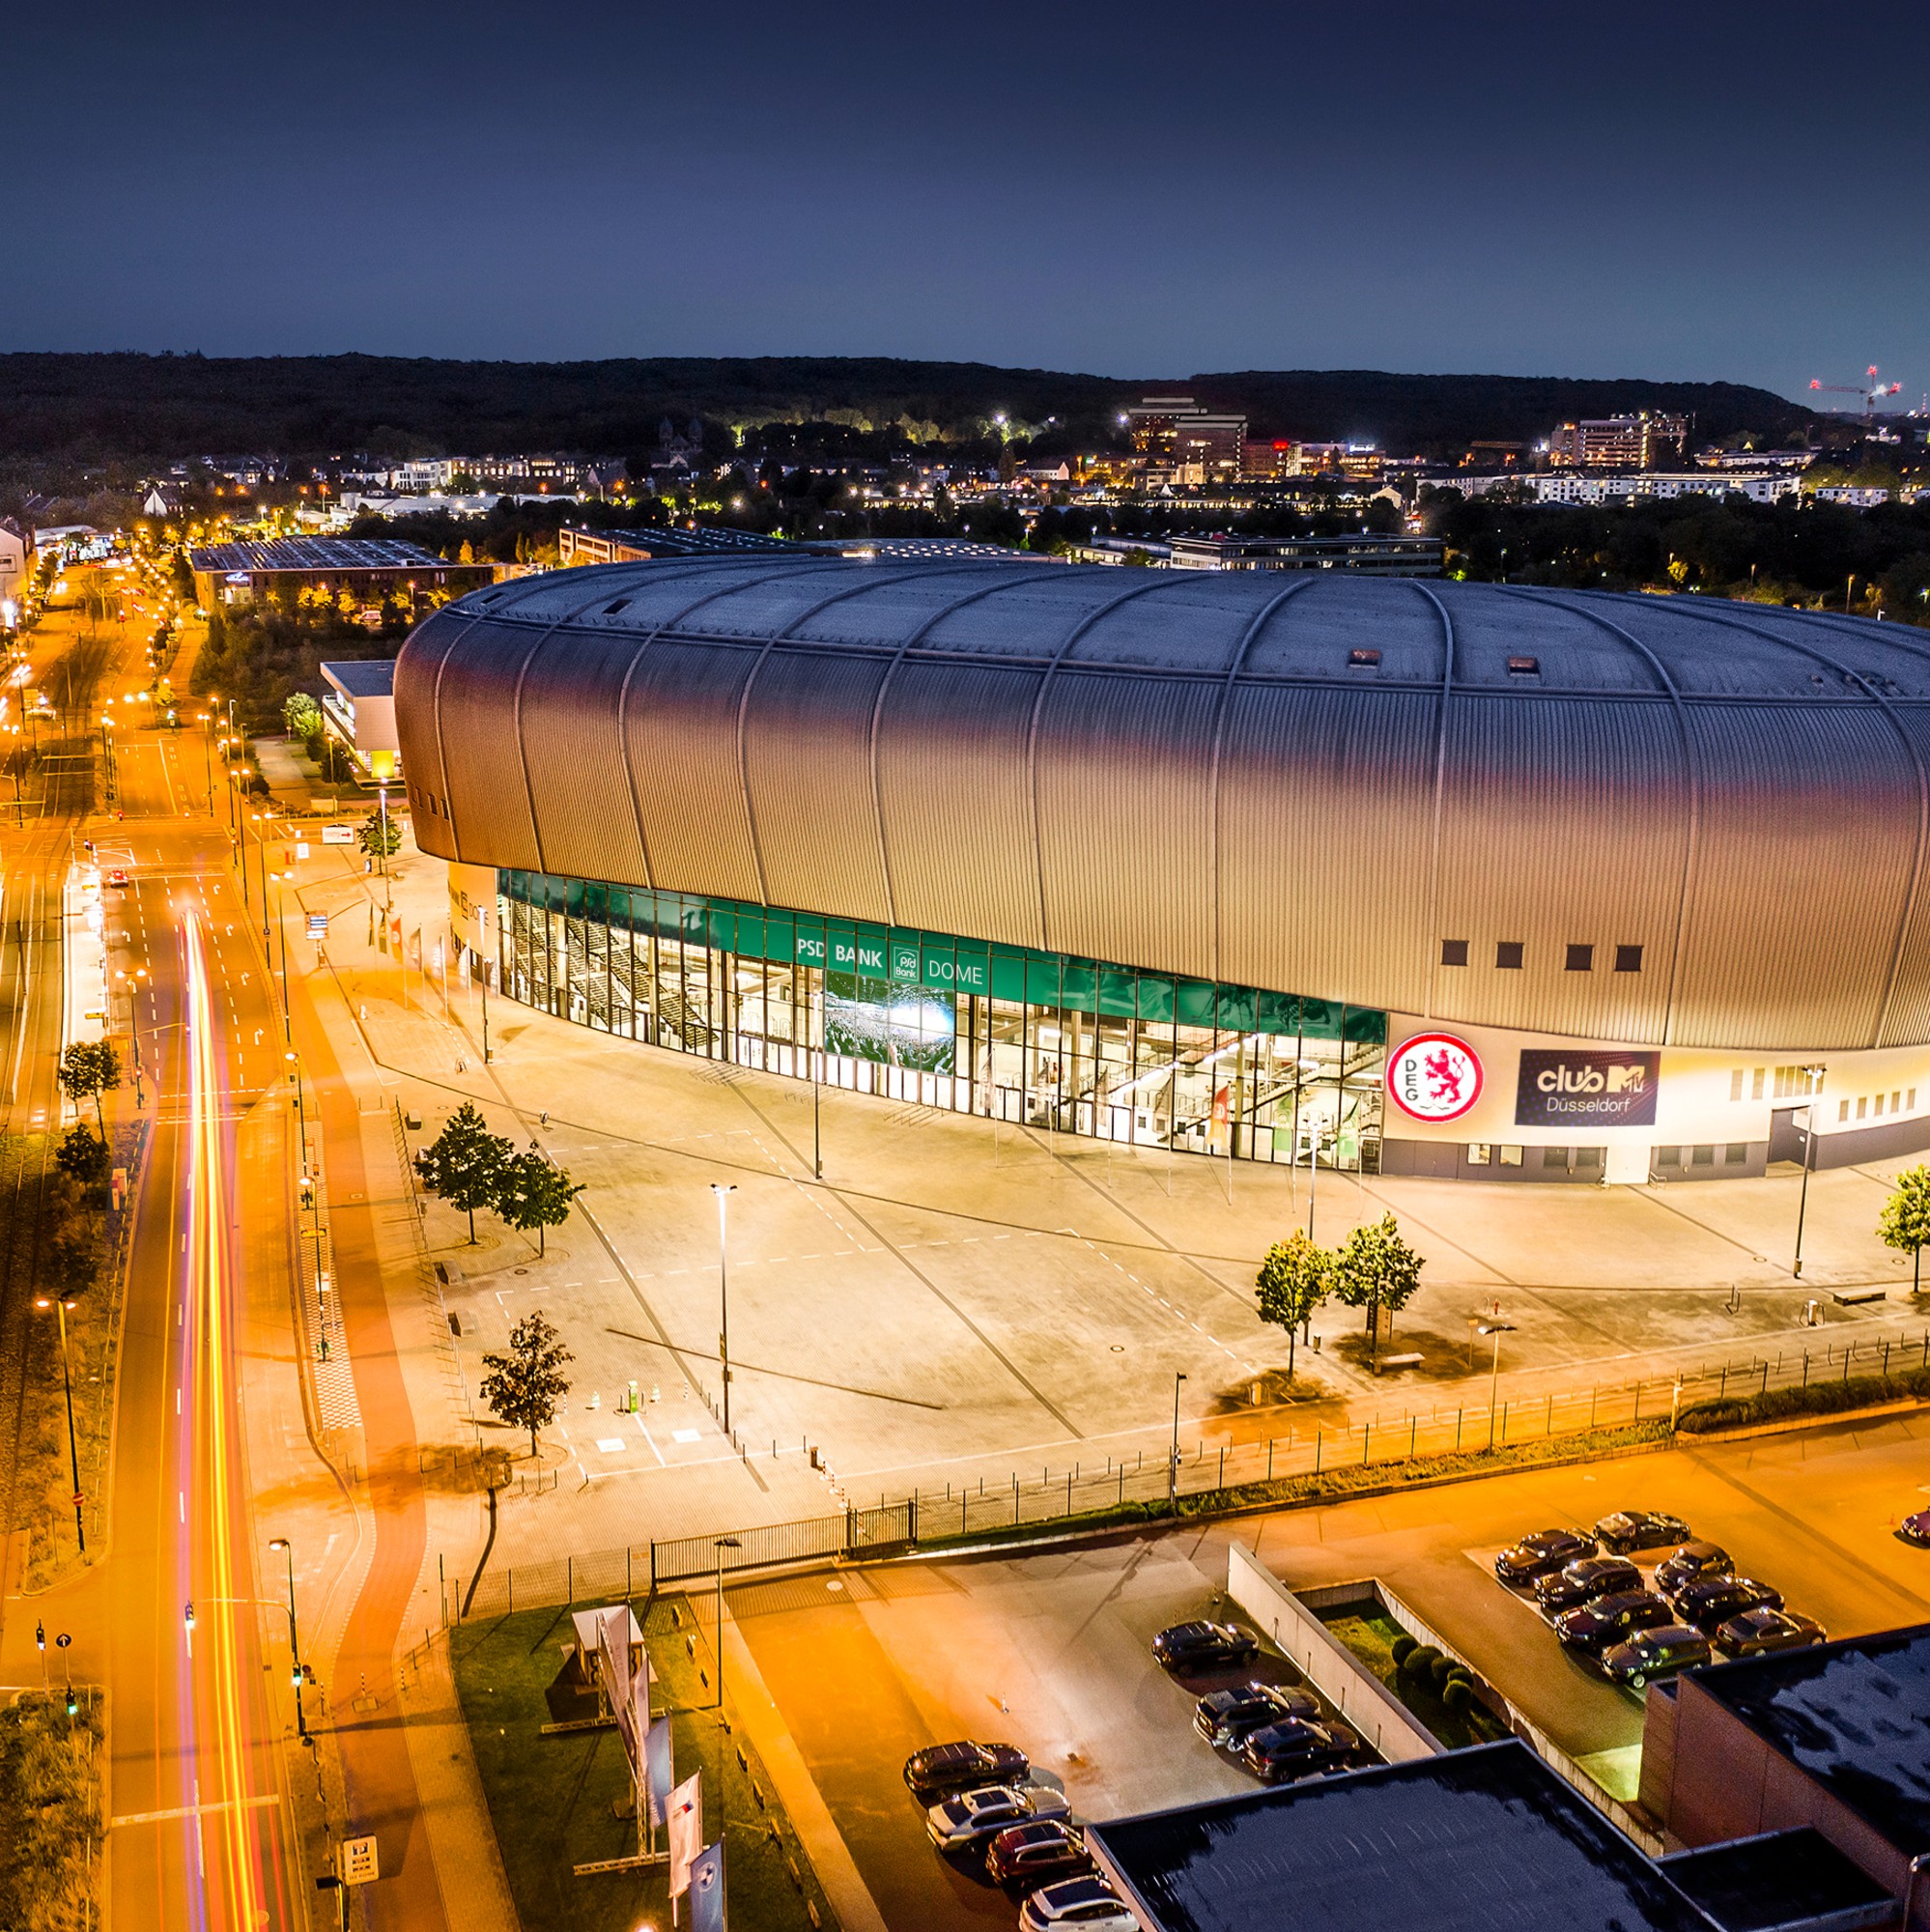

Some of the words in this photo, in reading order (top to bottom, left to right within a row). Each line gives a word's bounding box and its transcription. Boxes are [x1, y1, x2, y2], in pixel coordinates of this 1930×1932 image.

[798, 938, 825, 958] PSD
[836, 944, 883, 969] BANK
[895, 966, 917, 980] Bank
[929, 959, 983, 985] DOME
[1537, 1065, 1604, 1094] club
[1606, 1065, 1645, 1094] MTV
[1547, 1096, 1632, 1113] Düsseldorf
